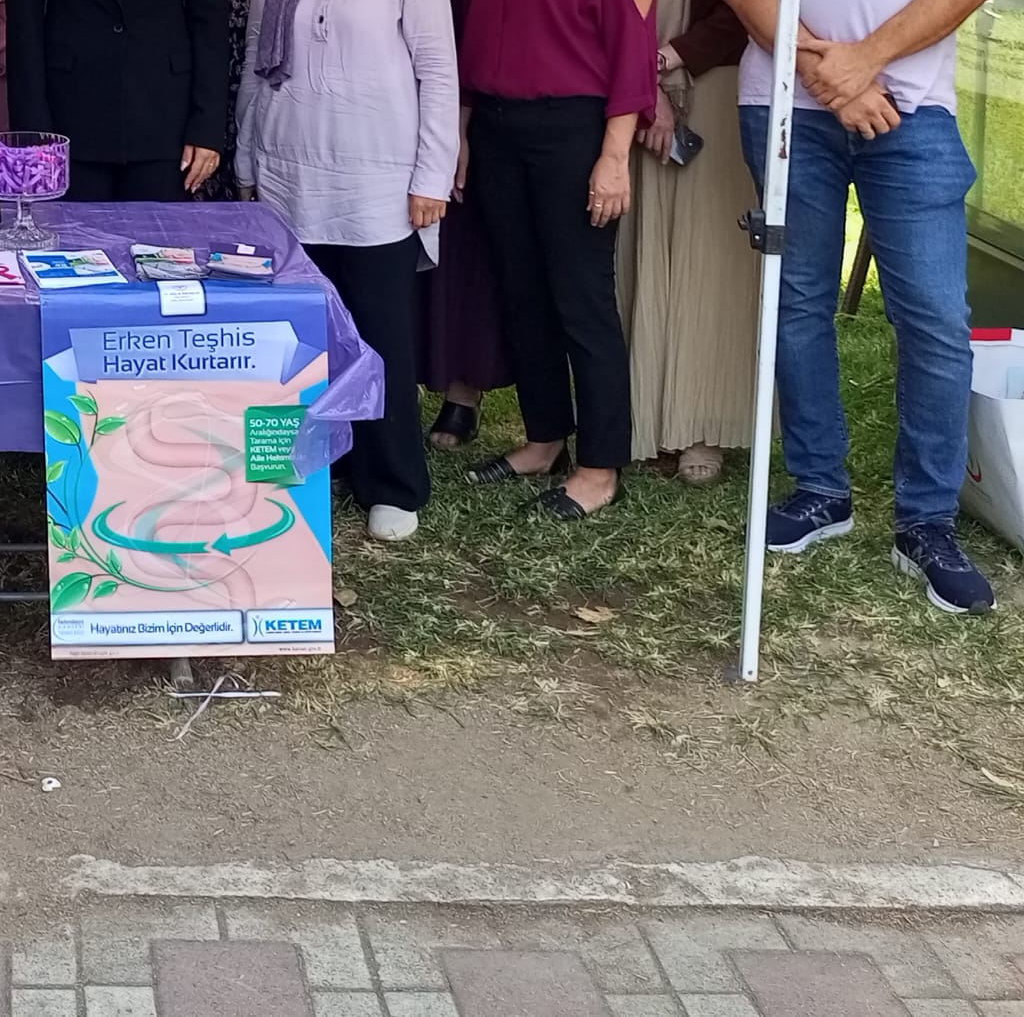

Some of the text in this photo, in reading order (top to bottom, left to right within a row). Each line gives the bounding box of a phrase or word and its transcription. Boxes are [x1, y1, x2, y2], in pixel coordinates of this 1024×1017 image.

[103, 327, 256, 353] Erken Teşhis
[103, 353, 256, 377] Hayat Kurtarır.
[249, 417, 300, 428] 50-70 YAŞ
[250, 445, 292, 454] KETEM vey
[91, 623, 136, 636] Hayatınız
[138, 623, 165, 633] Bizim
[166, 621, 183, 635] İçin
[185, 622, 234, 634] Değerlidir.
[265, 619, 322, 631] KETEM
